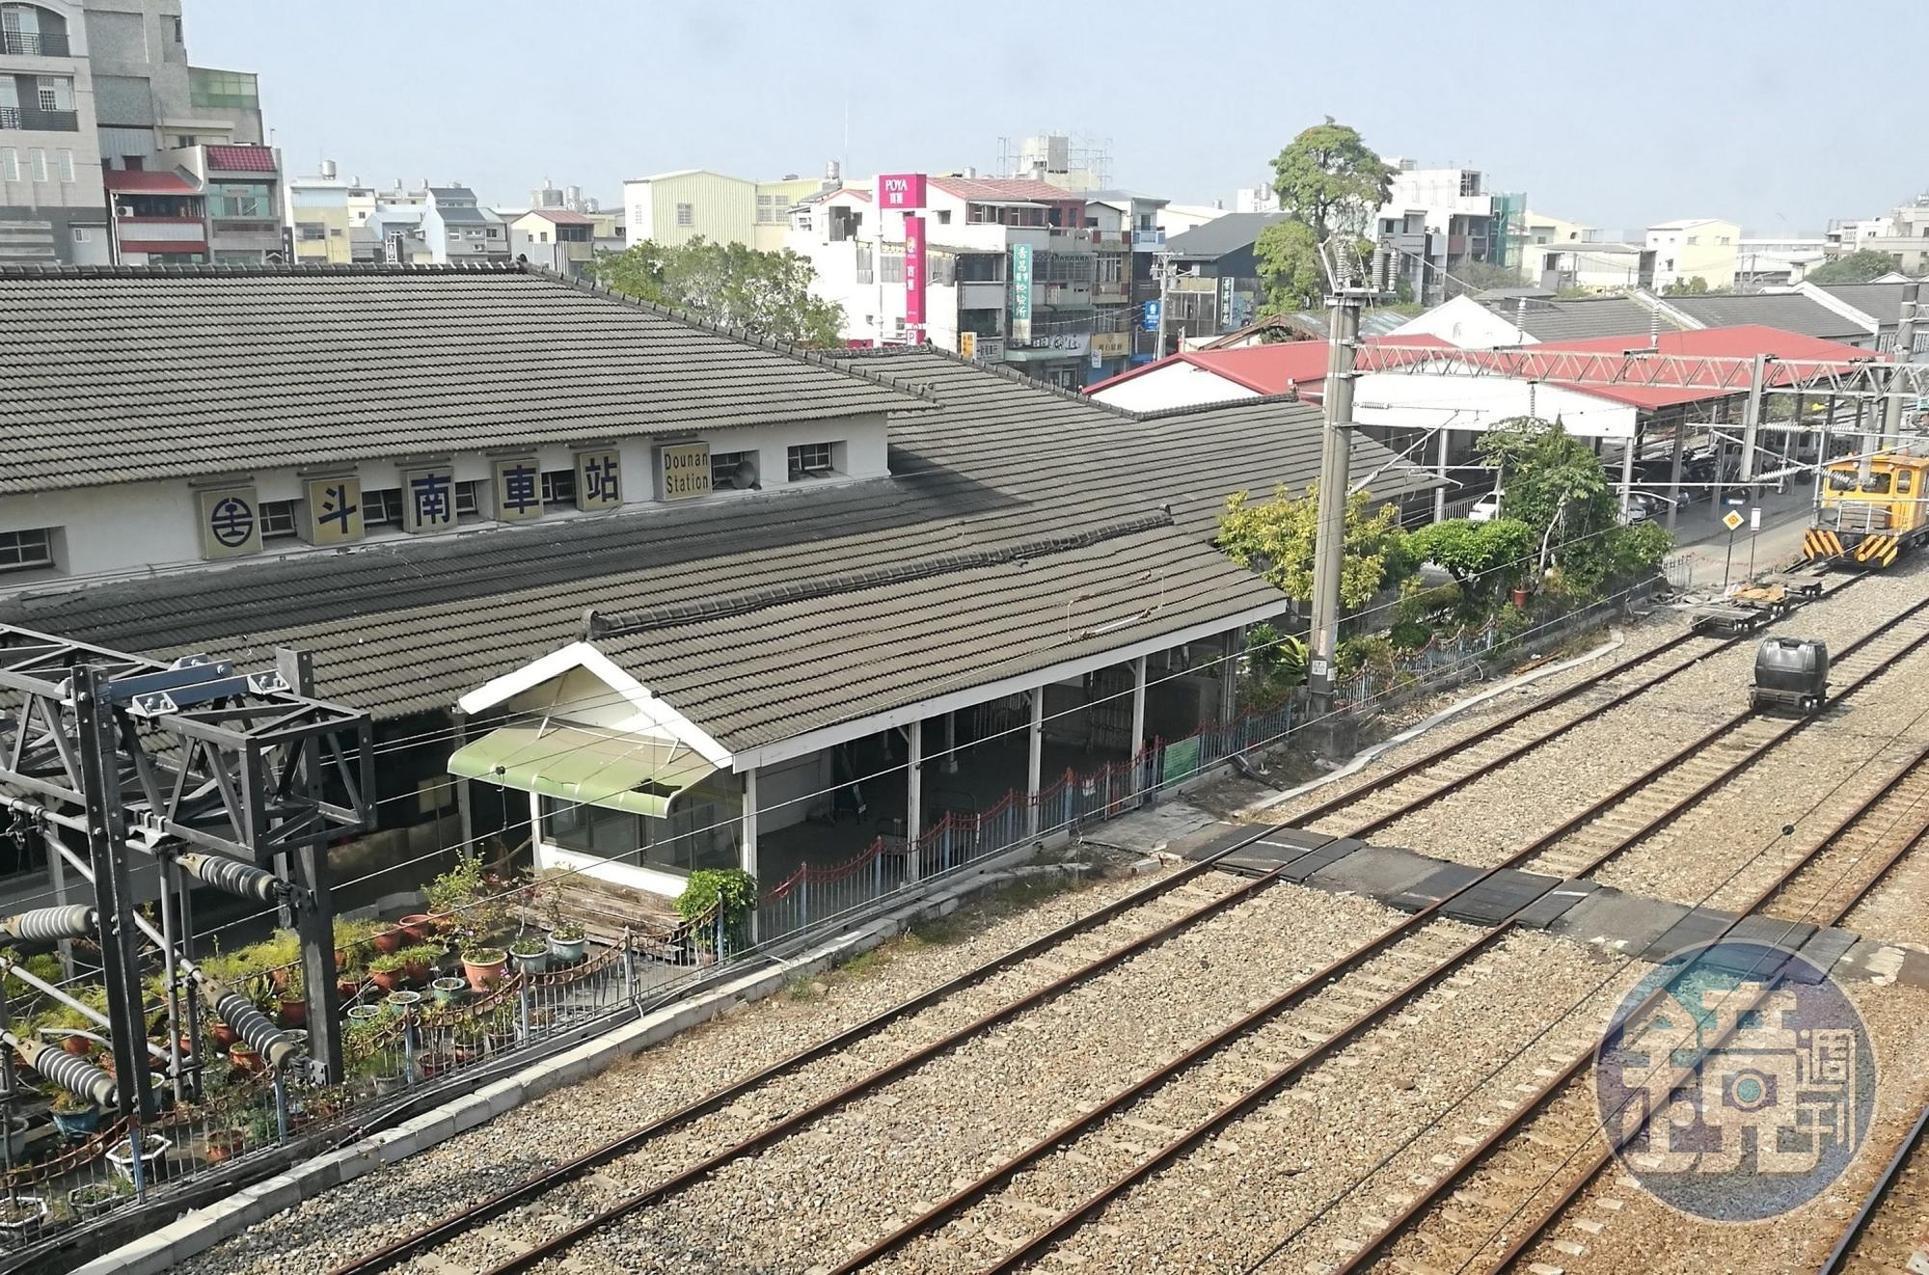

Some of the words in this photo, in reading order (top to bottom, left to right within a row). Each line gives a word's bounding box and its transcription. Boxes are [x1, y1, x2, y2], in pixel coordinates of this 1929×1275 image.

[885, 179, 908, 191] POYA
[664, 453, 708, 470] Dounan
[666, 473, 709, 494] Station
[318, 455, 619, 535] 斗南車站
